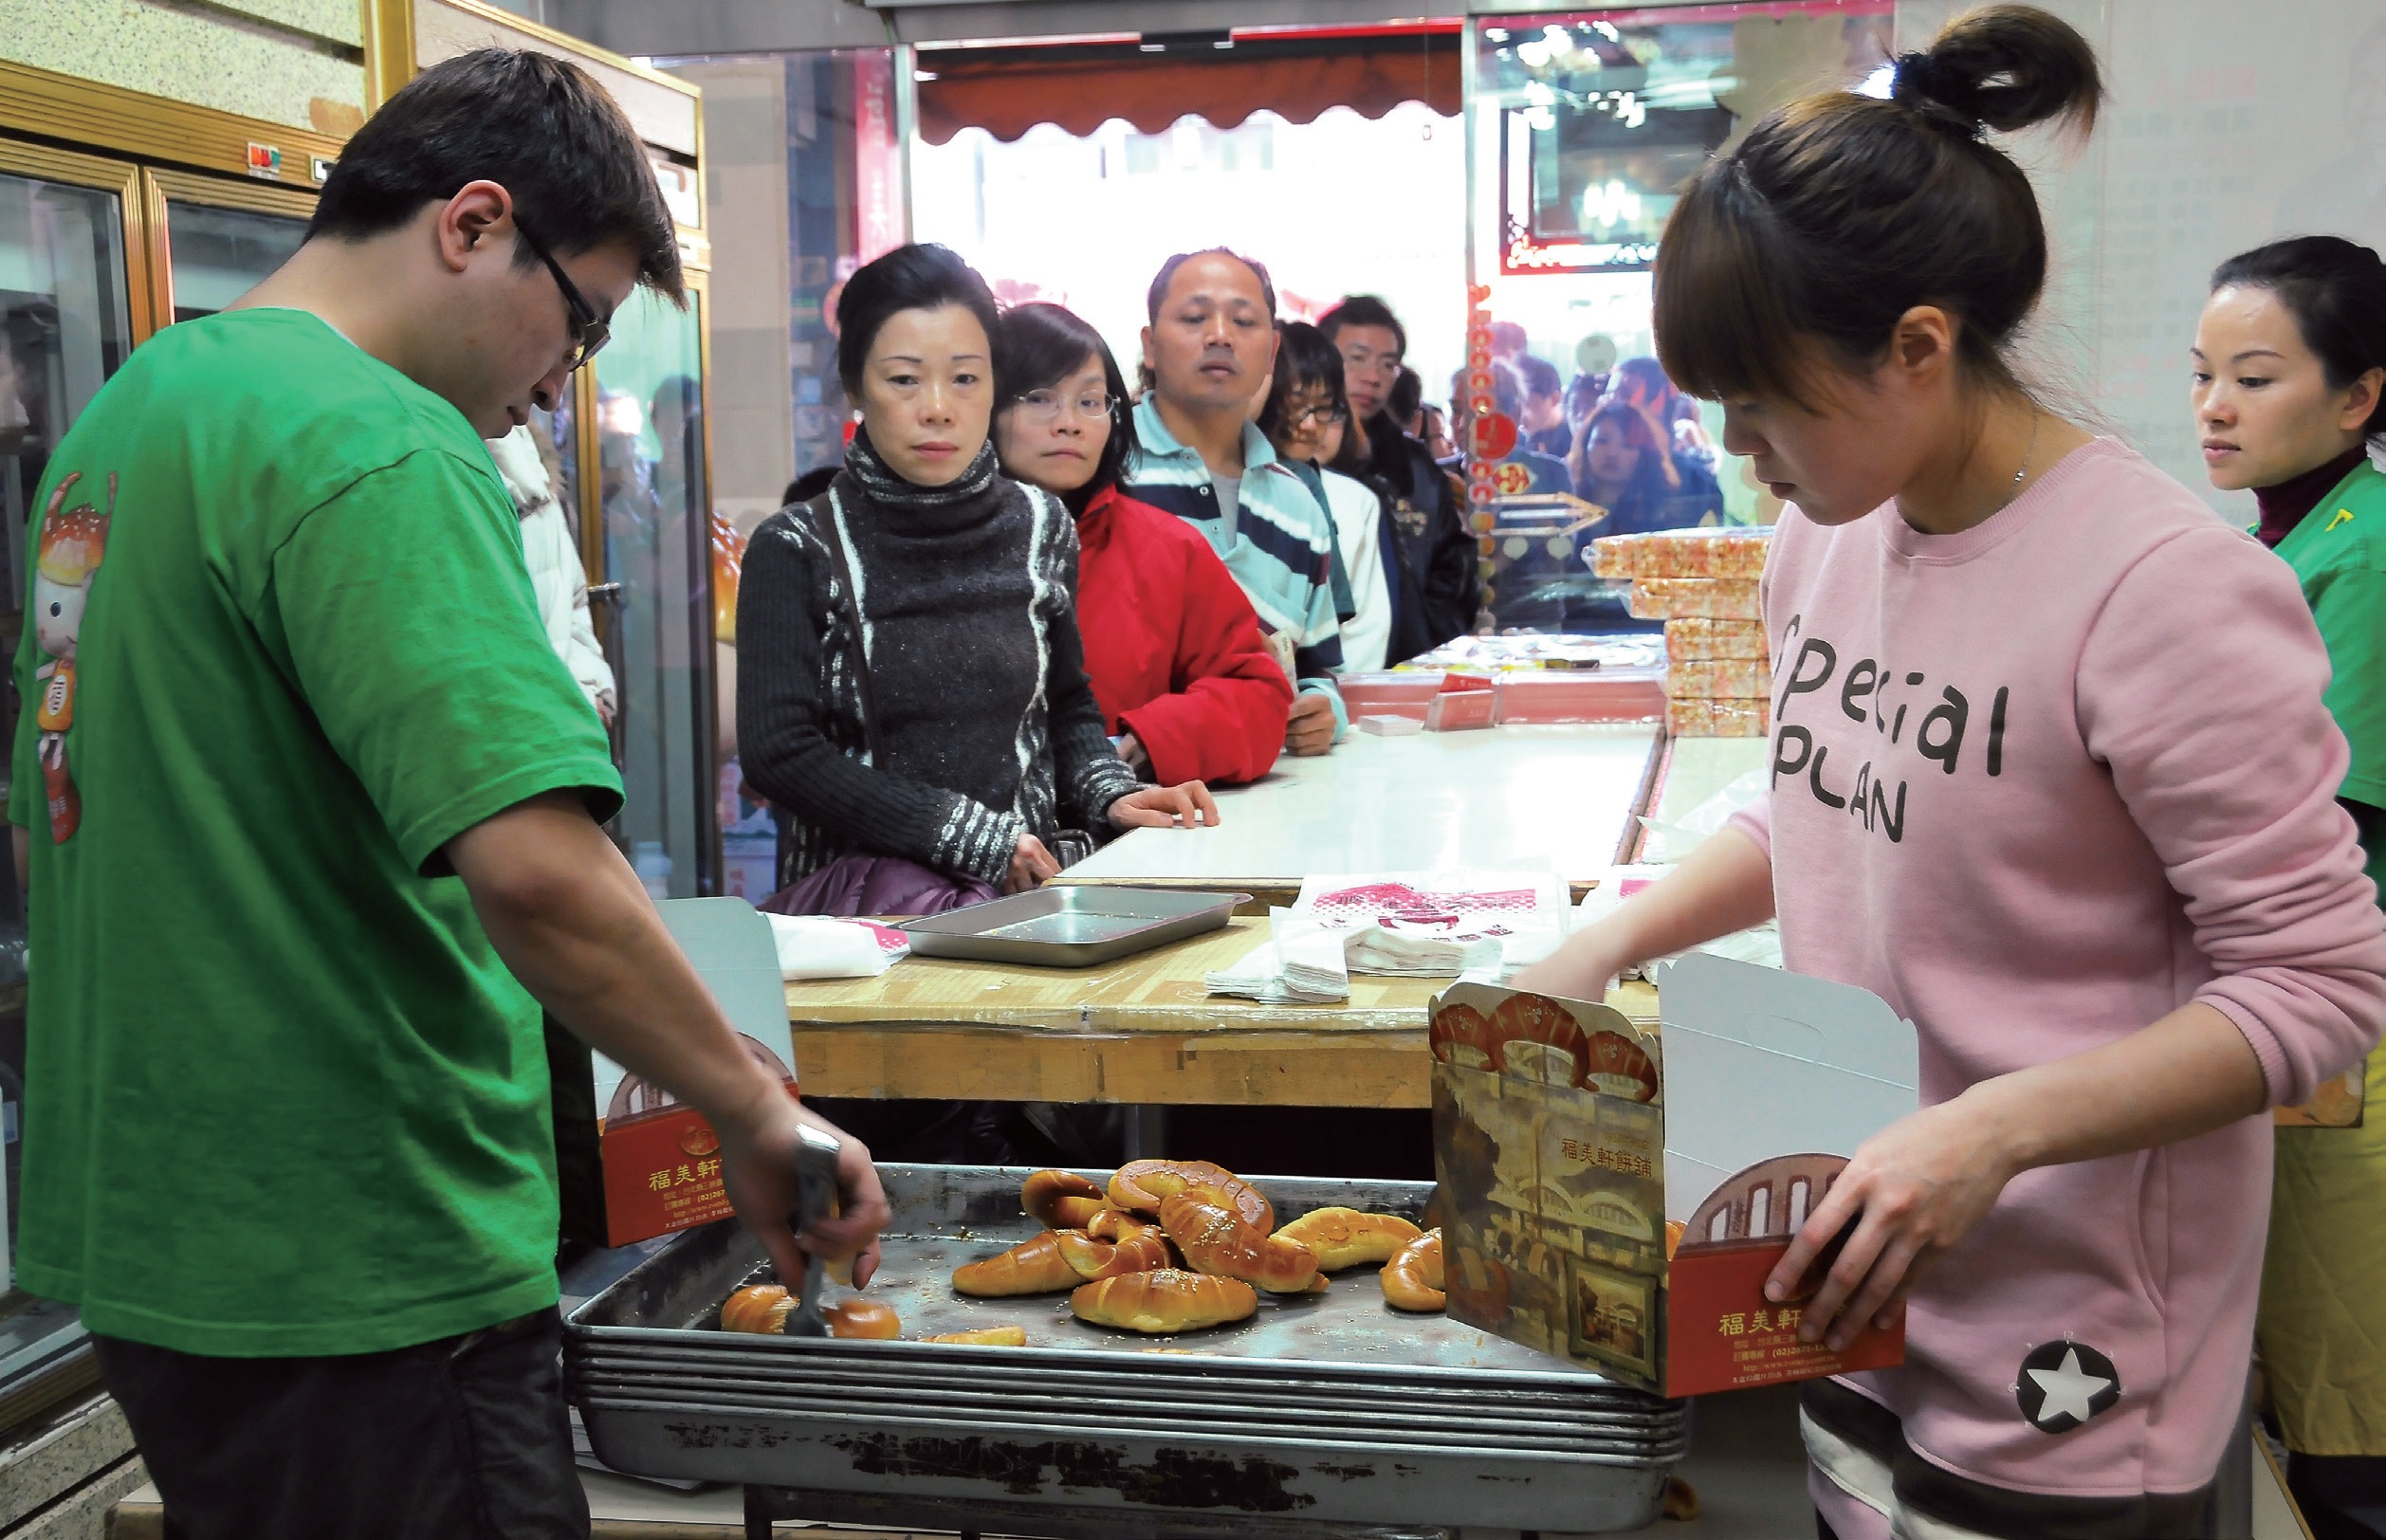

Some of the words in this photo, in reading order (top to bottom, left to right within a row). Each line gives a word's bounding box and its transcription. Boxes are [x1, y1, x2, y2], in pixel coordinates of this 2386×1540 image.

[1772, 724, 1907, 843] PLAN
[649, 1159, 722, 1191] 福美軒
[1561, 1138, 1652, 1178] 福美軒餅舖
[1718, 1309, 1802, 1336] 福美軒
